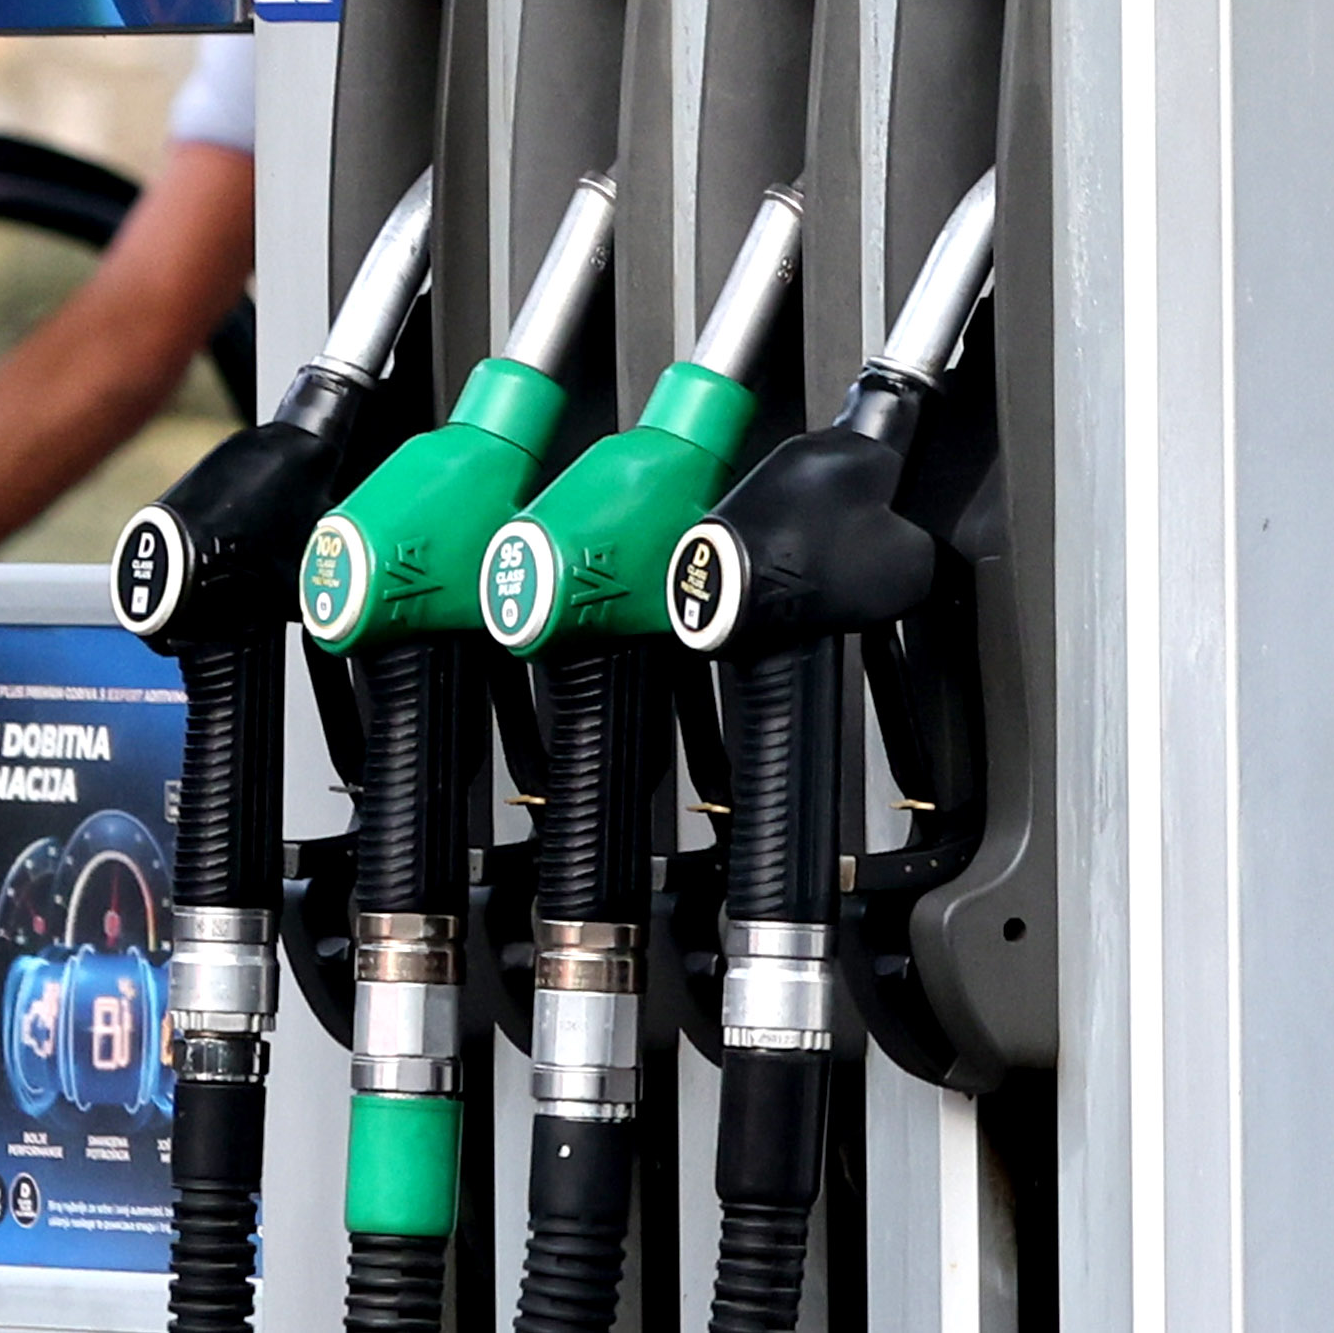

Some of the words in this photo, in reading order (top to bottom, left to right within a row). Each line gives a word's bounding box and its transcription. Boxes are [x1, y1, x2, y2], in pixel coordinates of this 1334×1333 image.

[138, 532, 155, 559] D
[316, 535, 342, 557] 100
[499, 542, 524, 569] 95
[692, 542, 711, 568] D
[495, 569, 525, 585] CLASS
[497, 583, 522, 597] PLUS
[1, 723, 111, 761] DOBITNA
